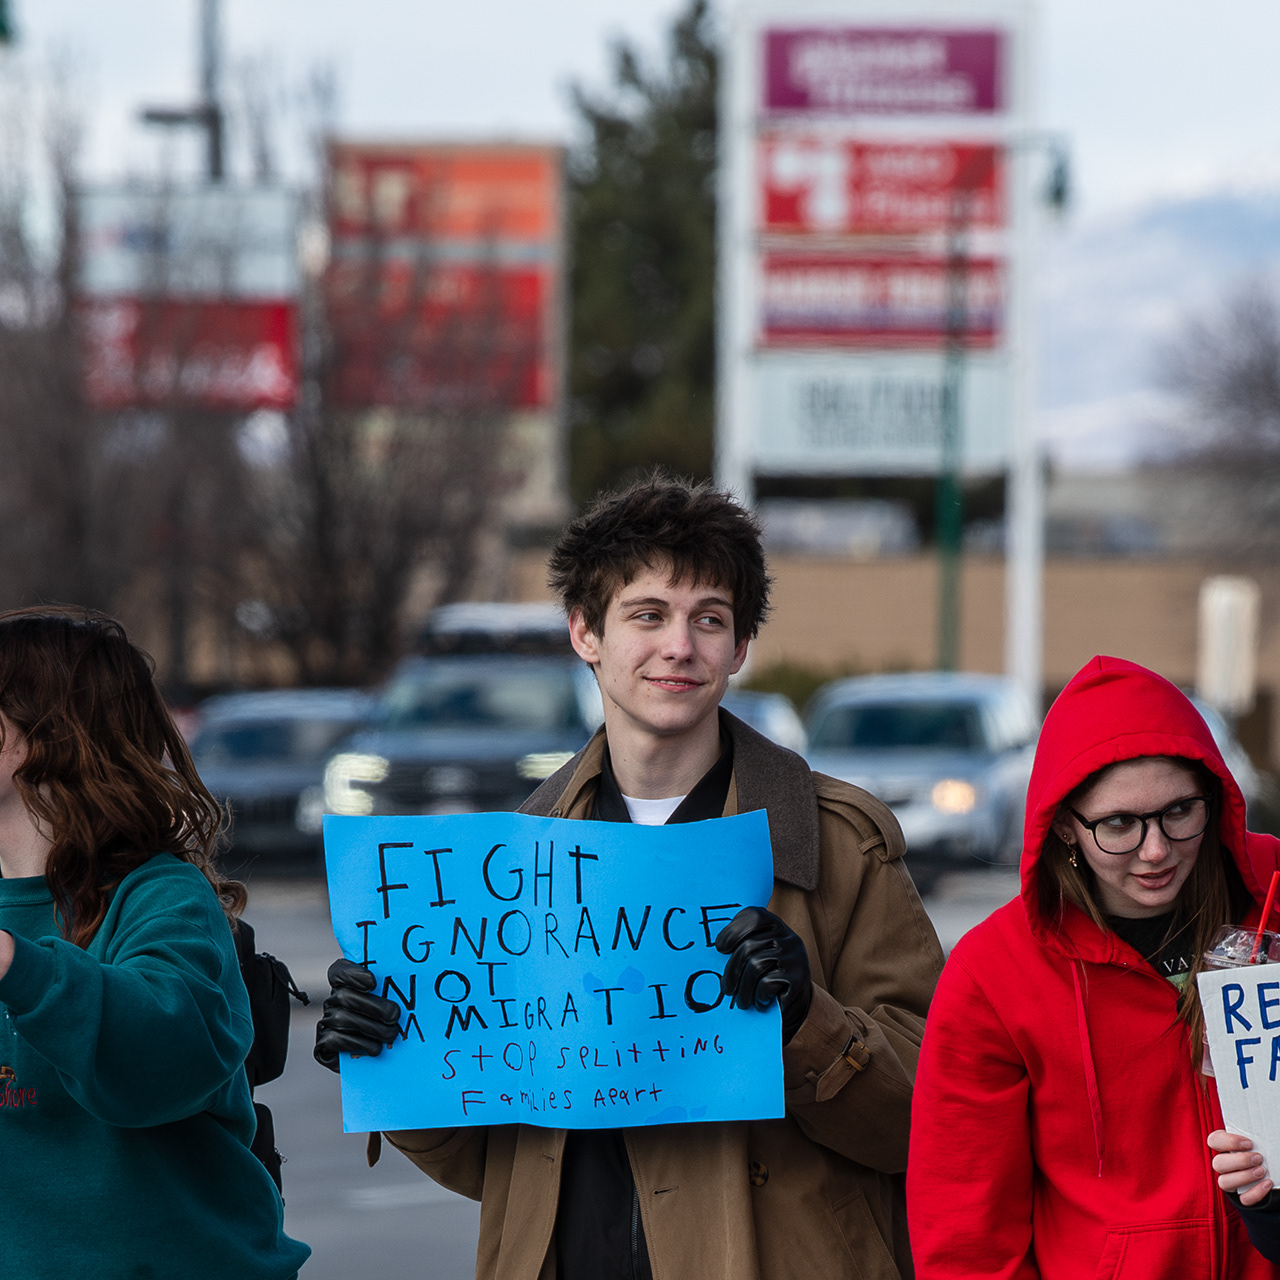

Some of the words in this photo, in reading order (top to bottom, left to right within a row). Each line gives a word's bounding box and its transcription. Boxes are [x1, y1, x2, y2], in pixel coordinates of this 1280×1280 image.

[376, 839, 600, 920] FIGHT
[354, 903, 743, 969] IGNORANCE
[381, 961, 508, 1012] NOT
[384, 968, 735, 1050] MMIGRATIO
